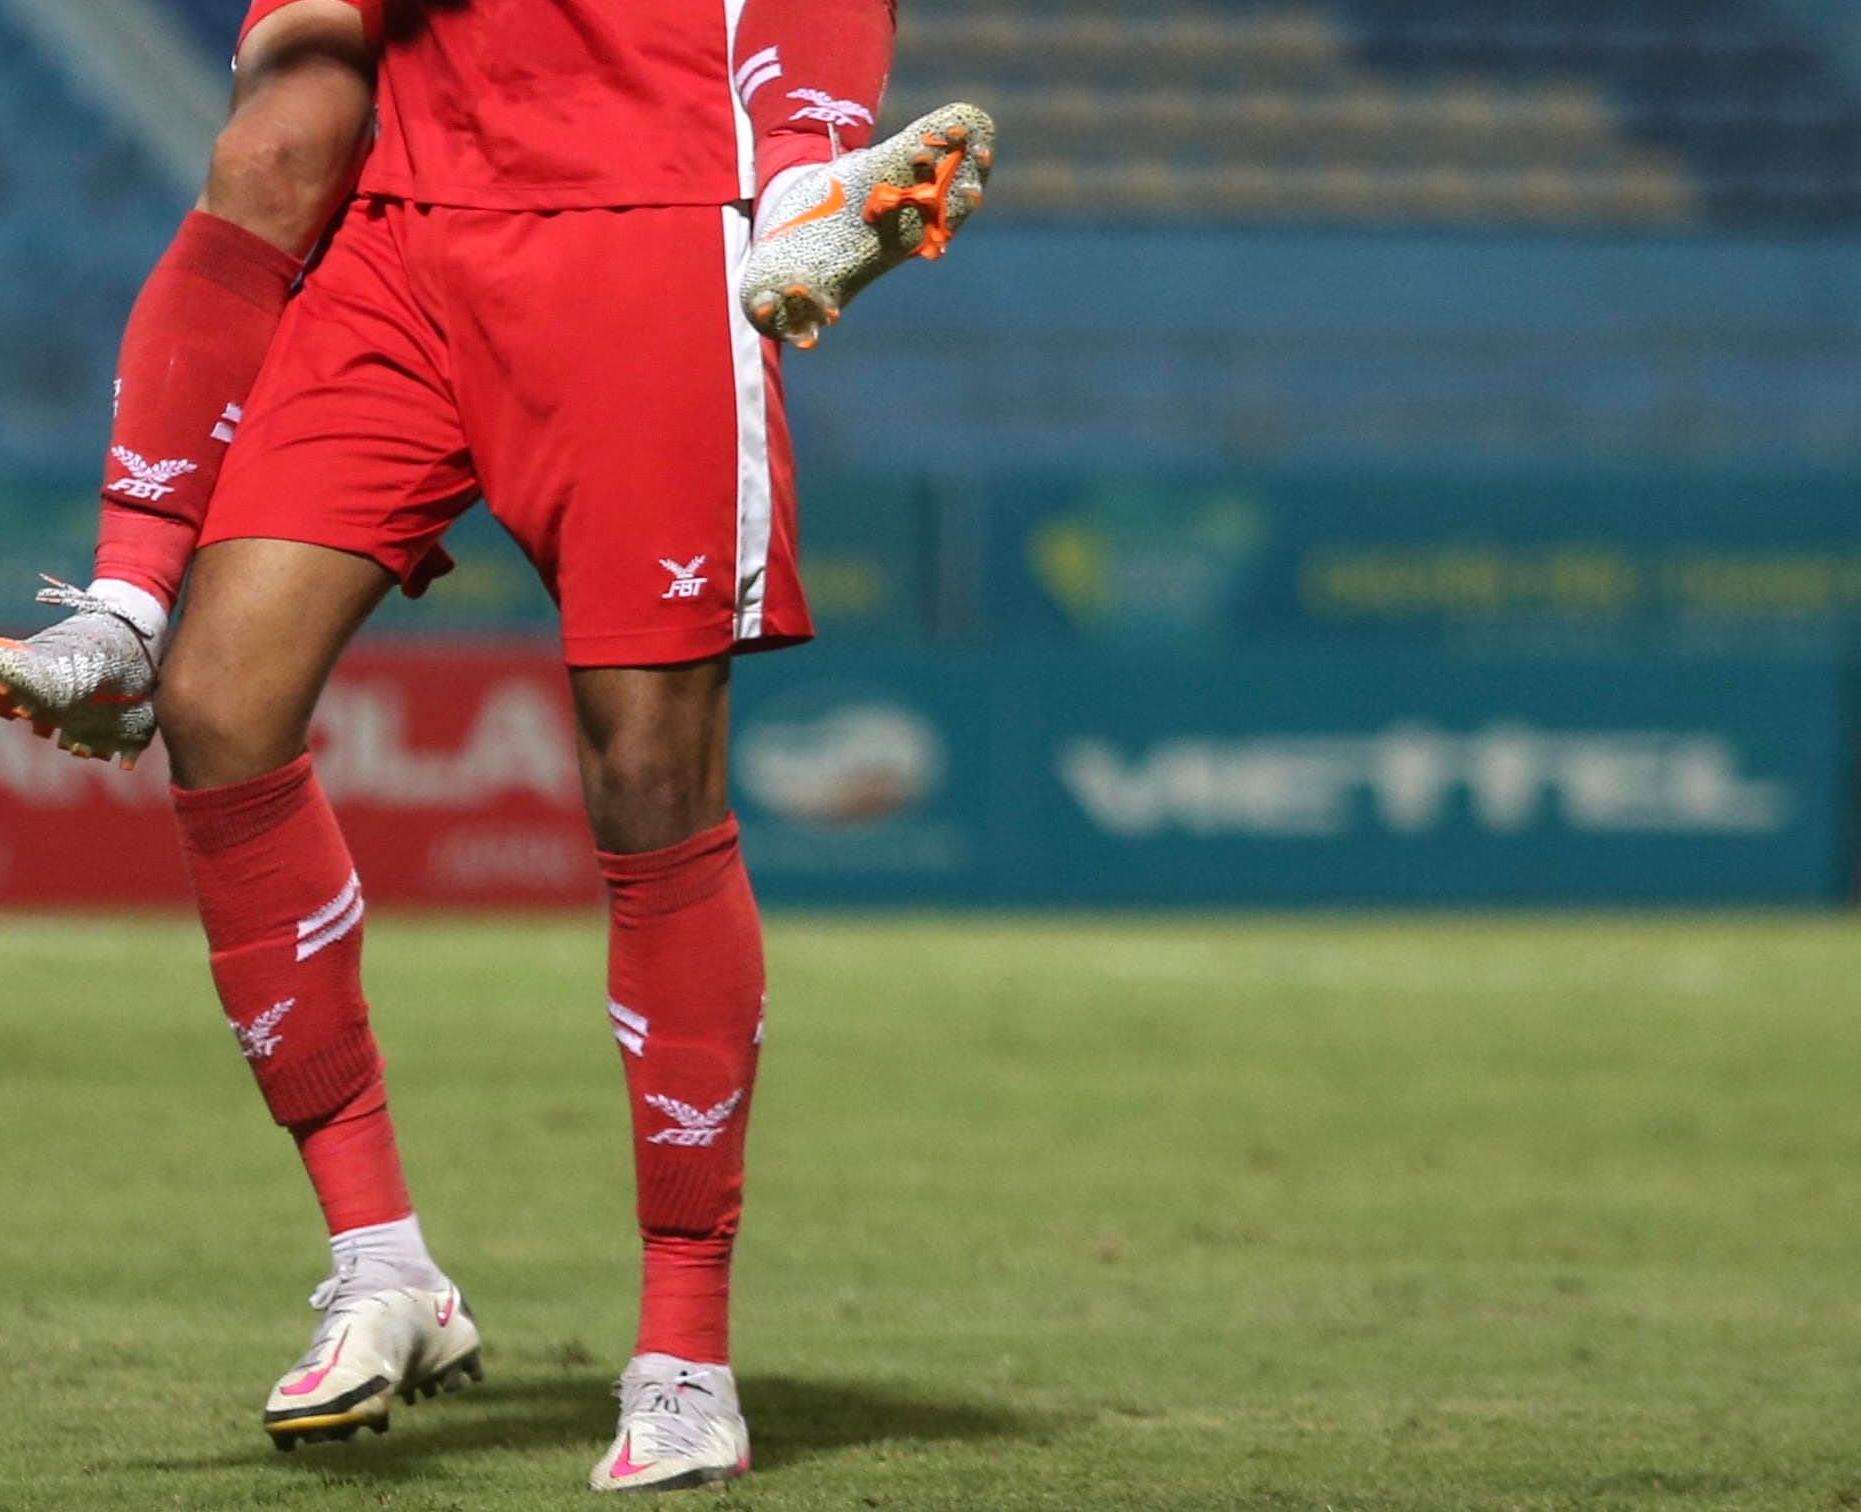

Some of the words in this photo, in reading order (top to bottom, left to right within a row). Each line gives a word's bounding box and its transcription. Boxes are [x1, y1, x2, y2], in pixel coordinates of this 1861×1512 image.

[787, 105, 860, 128] FBT
[106, 477, 176, 502] FBT
[660, 577, 708, 599] FBT
